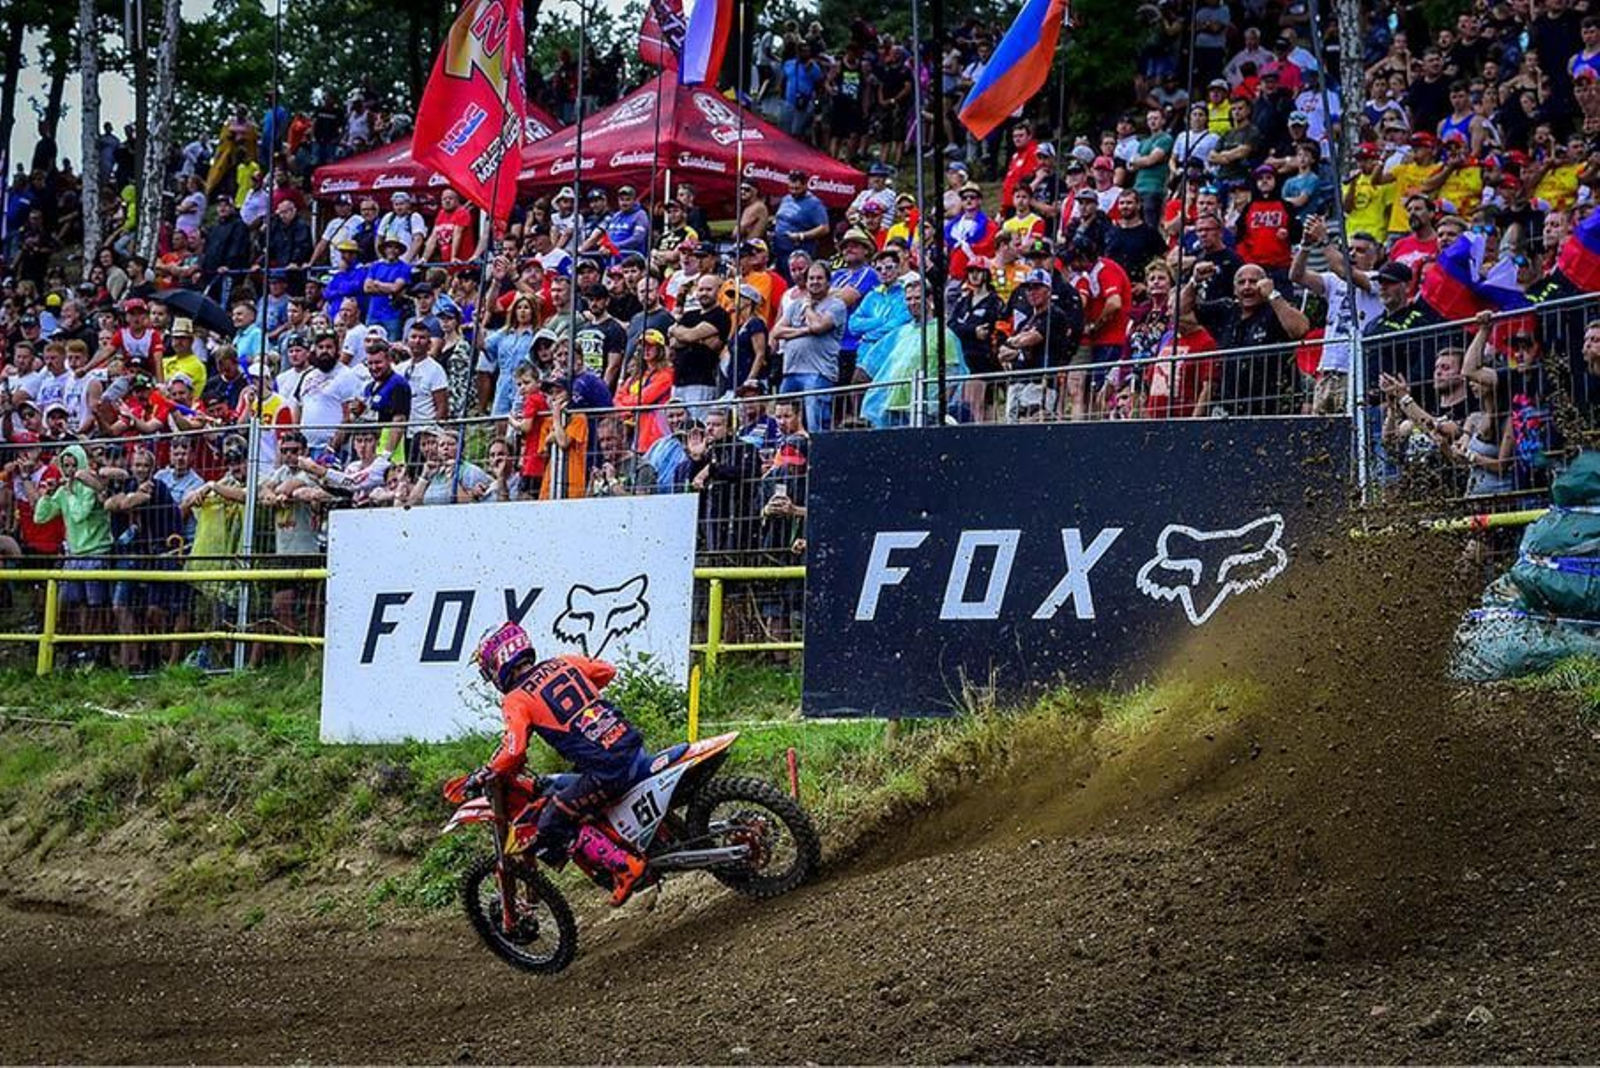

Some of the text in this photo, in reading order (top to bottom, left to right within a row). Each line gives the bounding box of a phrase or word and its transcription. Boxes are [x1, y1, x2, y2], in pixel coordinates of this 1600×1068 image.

[855, 528, 1123, 620] FOX
[541, 667, 596, 725] 61
[630, 790, 661, 829] 61
